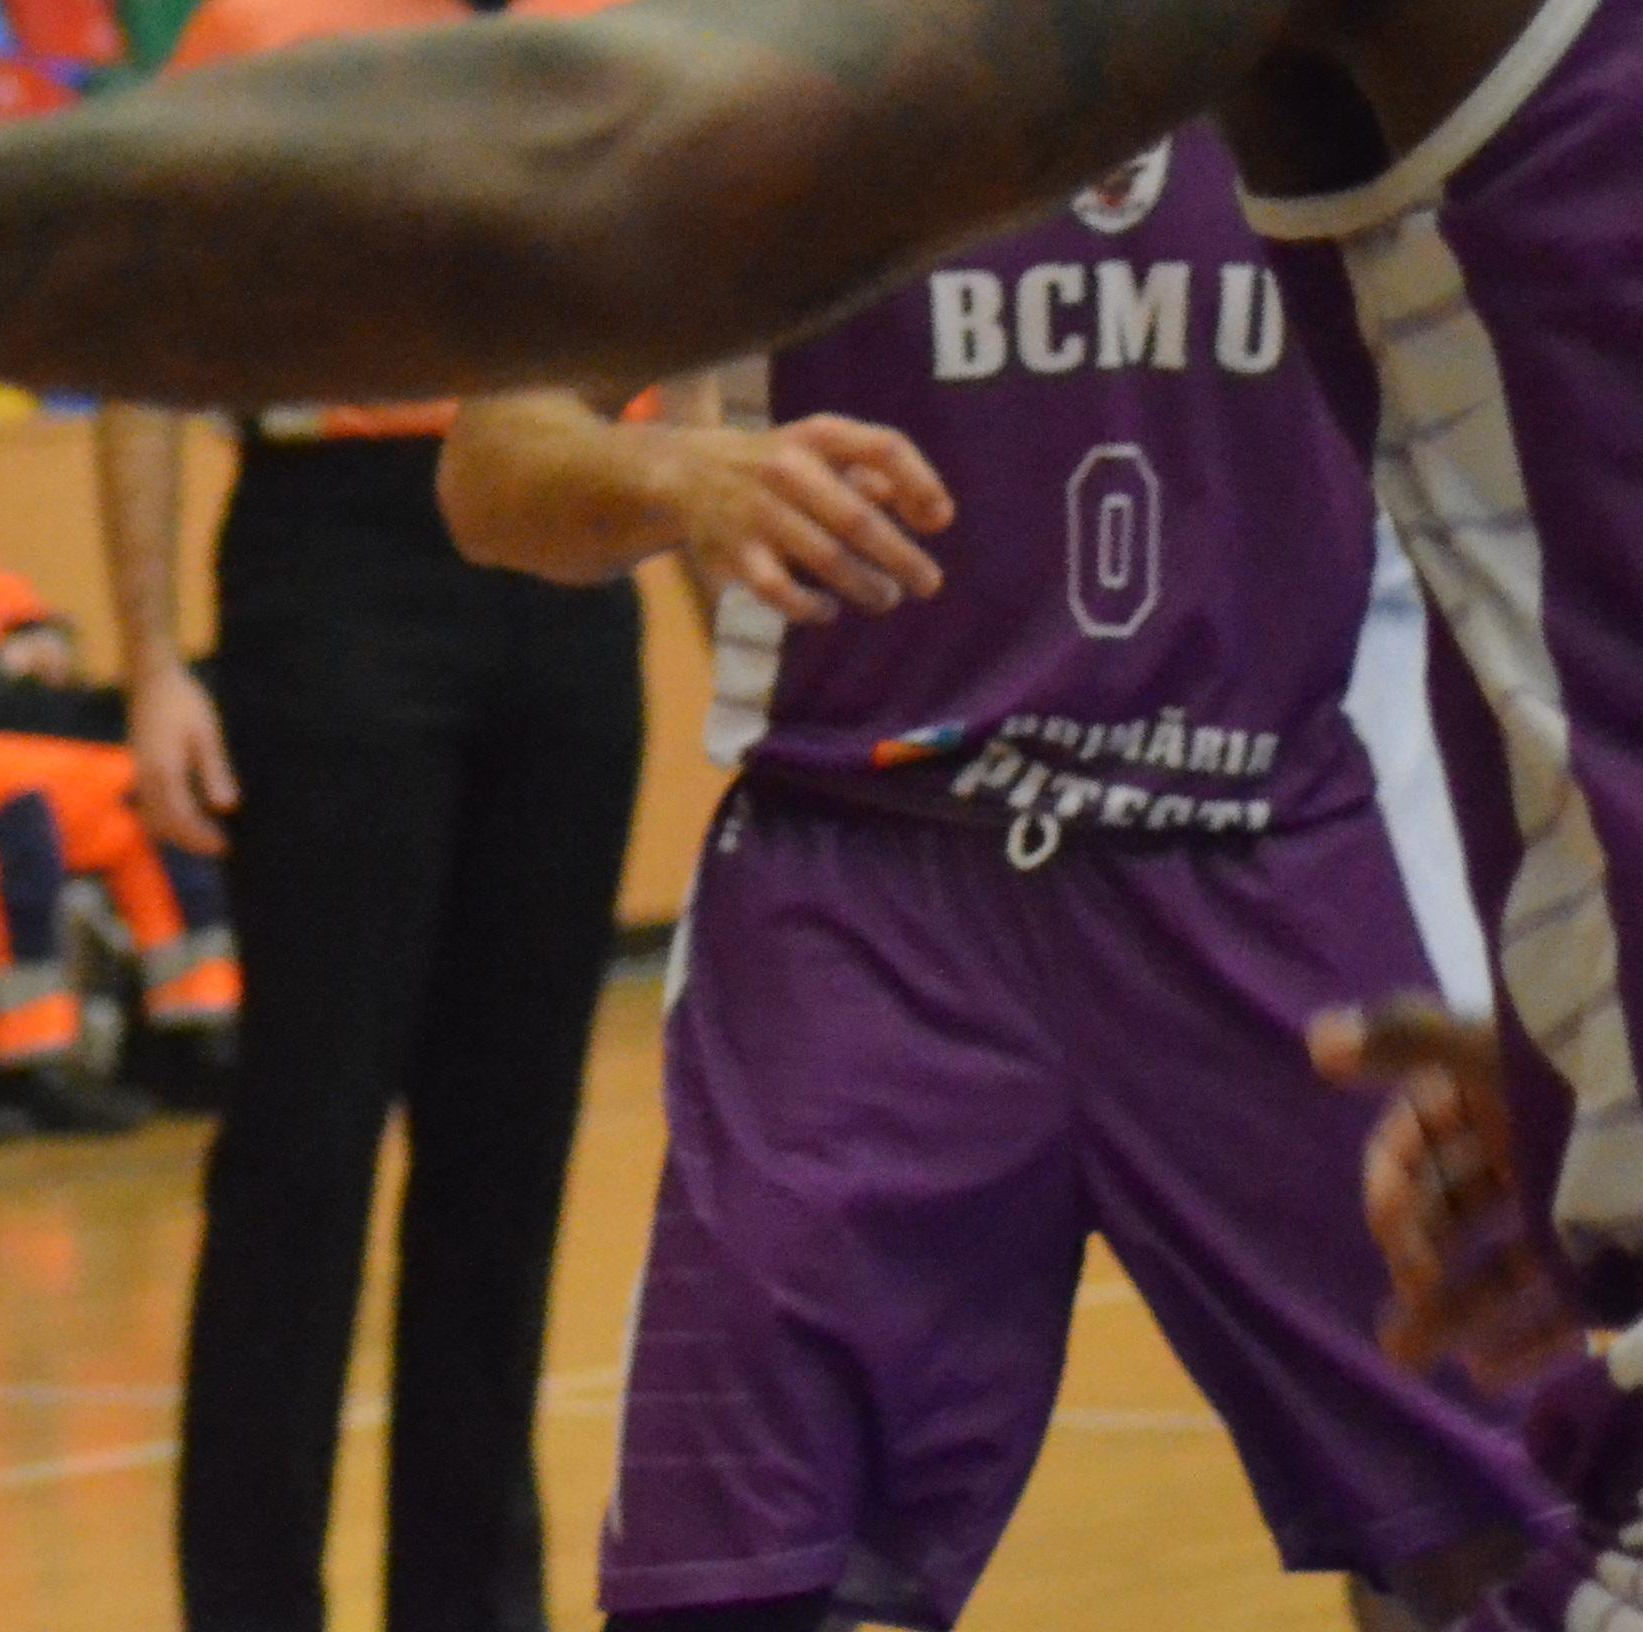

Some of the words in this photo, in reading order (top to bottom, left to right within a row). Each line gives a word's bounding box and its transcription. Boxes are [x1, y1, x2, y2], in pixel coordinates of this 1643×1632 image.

[929, 258, 1190, 381] BCM
[1216, 262, 1286, 375] U
[1066, 442, 1162, 639] 0
